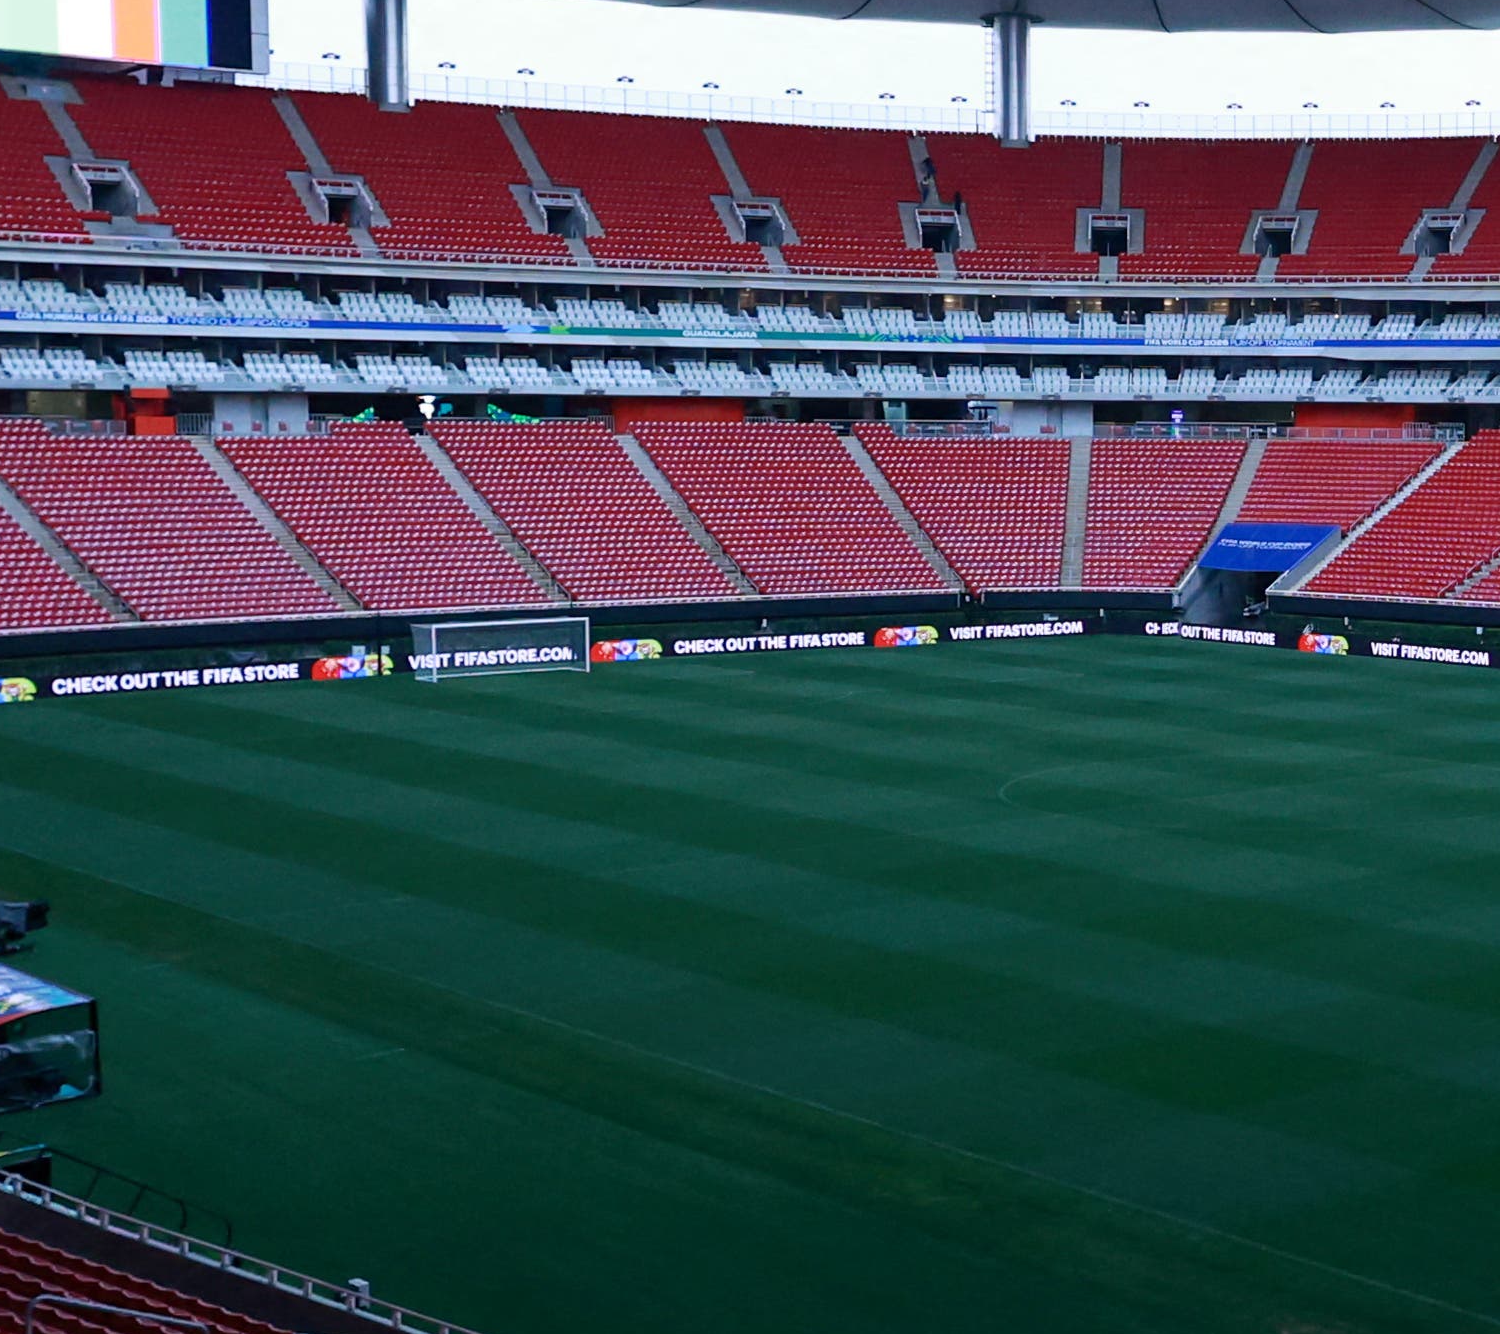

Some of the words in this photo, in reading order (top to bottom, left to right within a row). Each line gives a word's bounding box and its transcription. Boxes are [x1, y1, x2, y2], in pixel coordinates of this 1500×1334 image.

[682, 330, 757, 339] GUADALAJARA
[950, 626, 983, 639] VISIT
[985, 621, 1084, 638] FIFASTORE.COM
[1181, 625, 1202, 638] OUT
[1202, 627, 1220, 640] THE
[1222, 629, 1244, 642] FIFA
[1244, 631, 1275, 645] STORE
[674, 639, 724, 653] CHECK
[726, 637, 756, 651] OUT
[758, 636, 786, 649] THE
[790, 634, 821, 648] FIFA
[822, 632, 864, 646] STORE
[408, 652, 452, 669] VISIT
[1371, 642, 1399, 656] VISIT
[1401, 645, 1489, 665] FIFASTORE.COM
[52, 675, 118, 694] CHECK
[120, 673, 160, 689] OUT
[161, 670, 199, 687] THE
[203, 667, 243, 684] FIFA
[244, 664, 299, 681] STORE
